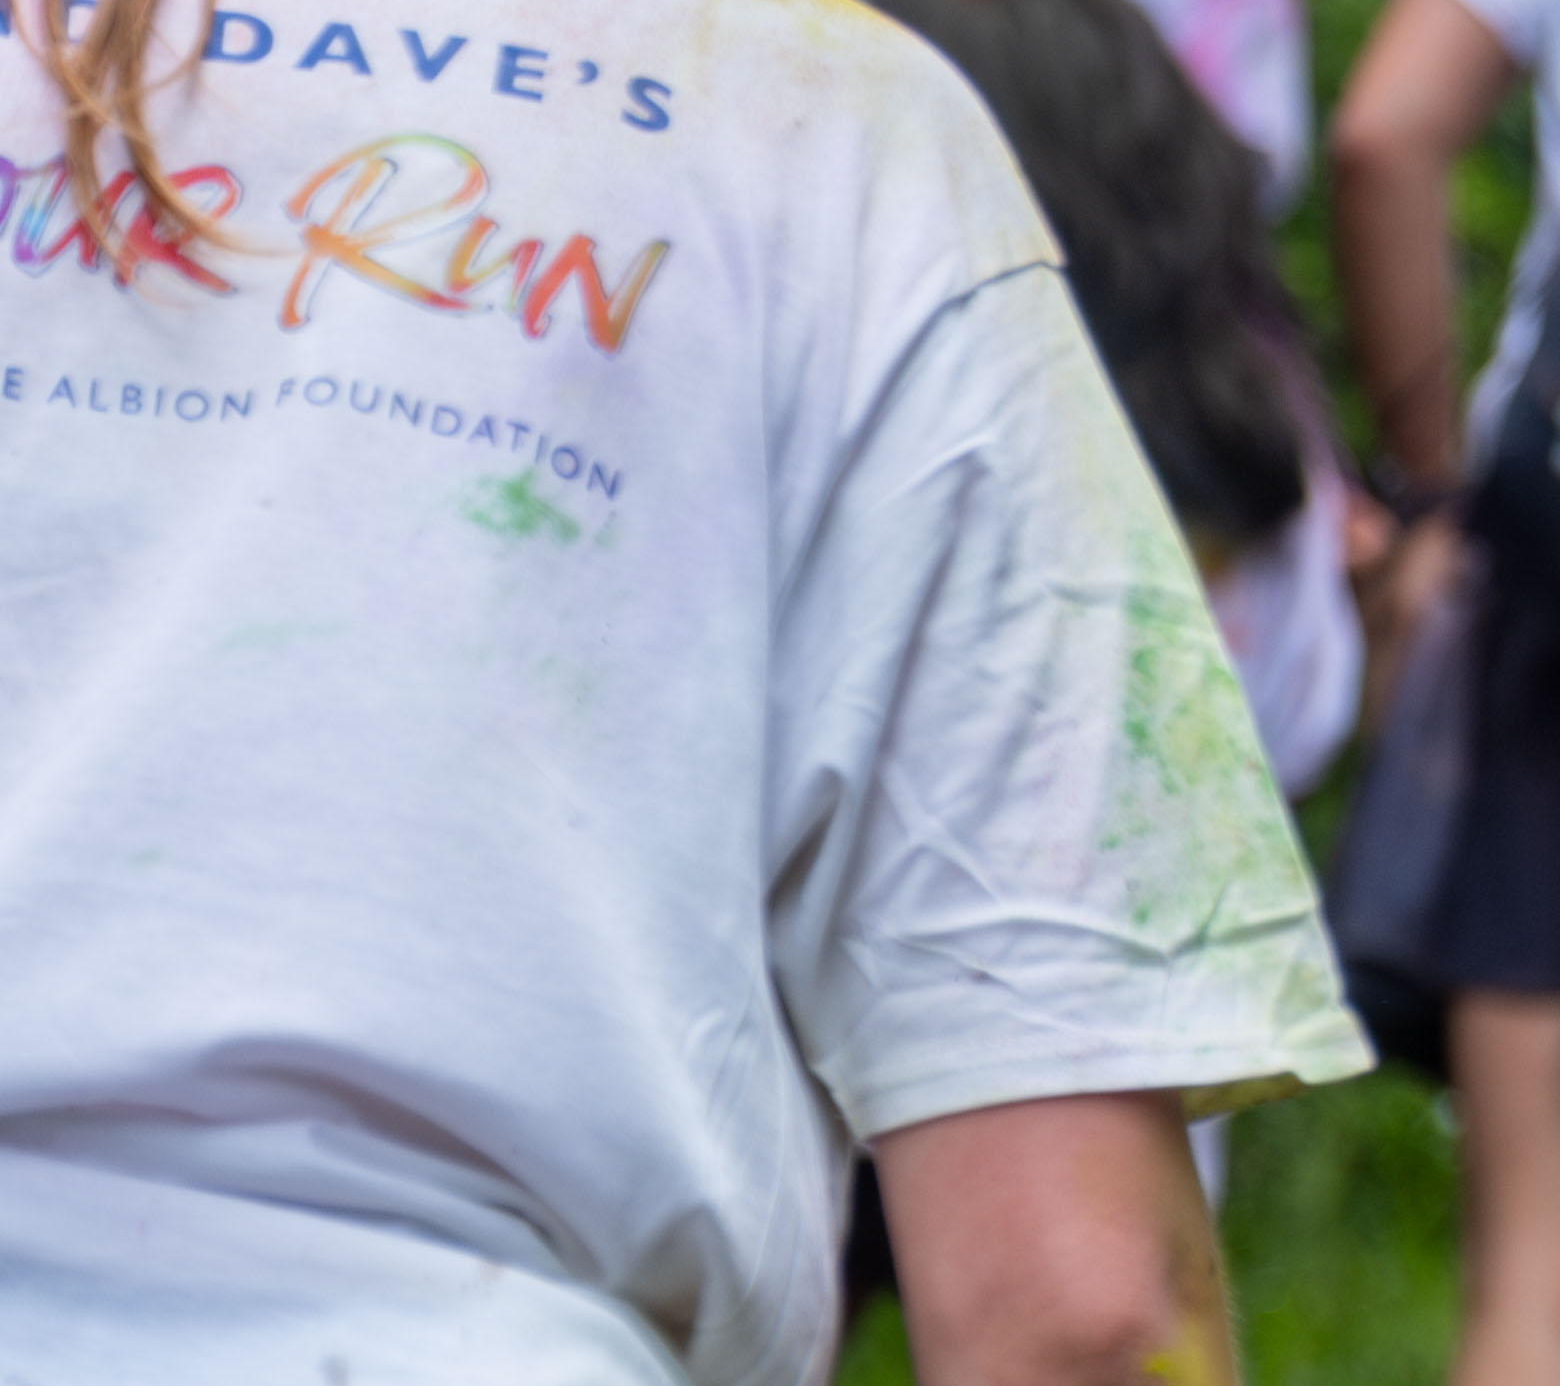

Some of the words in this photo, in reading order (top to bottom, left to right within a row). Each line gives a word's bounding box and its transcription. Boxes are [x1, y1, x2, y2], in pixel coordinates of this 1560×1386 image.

[203, 9, 674, 133] DAVE'S
[46, 375, 253, 422] ALBION
[274, 376, 623, 501] FOUNDATION
